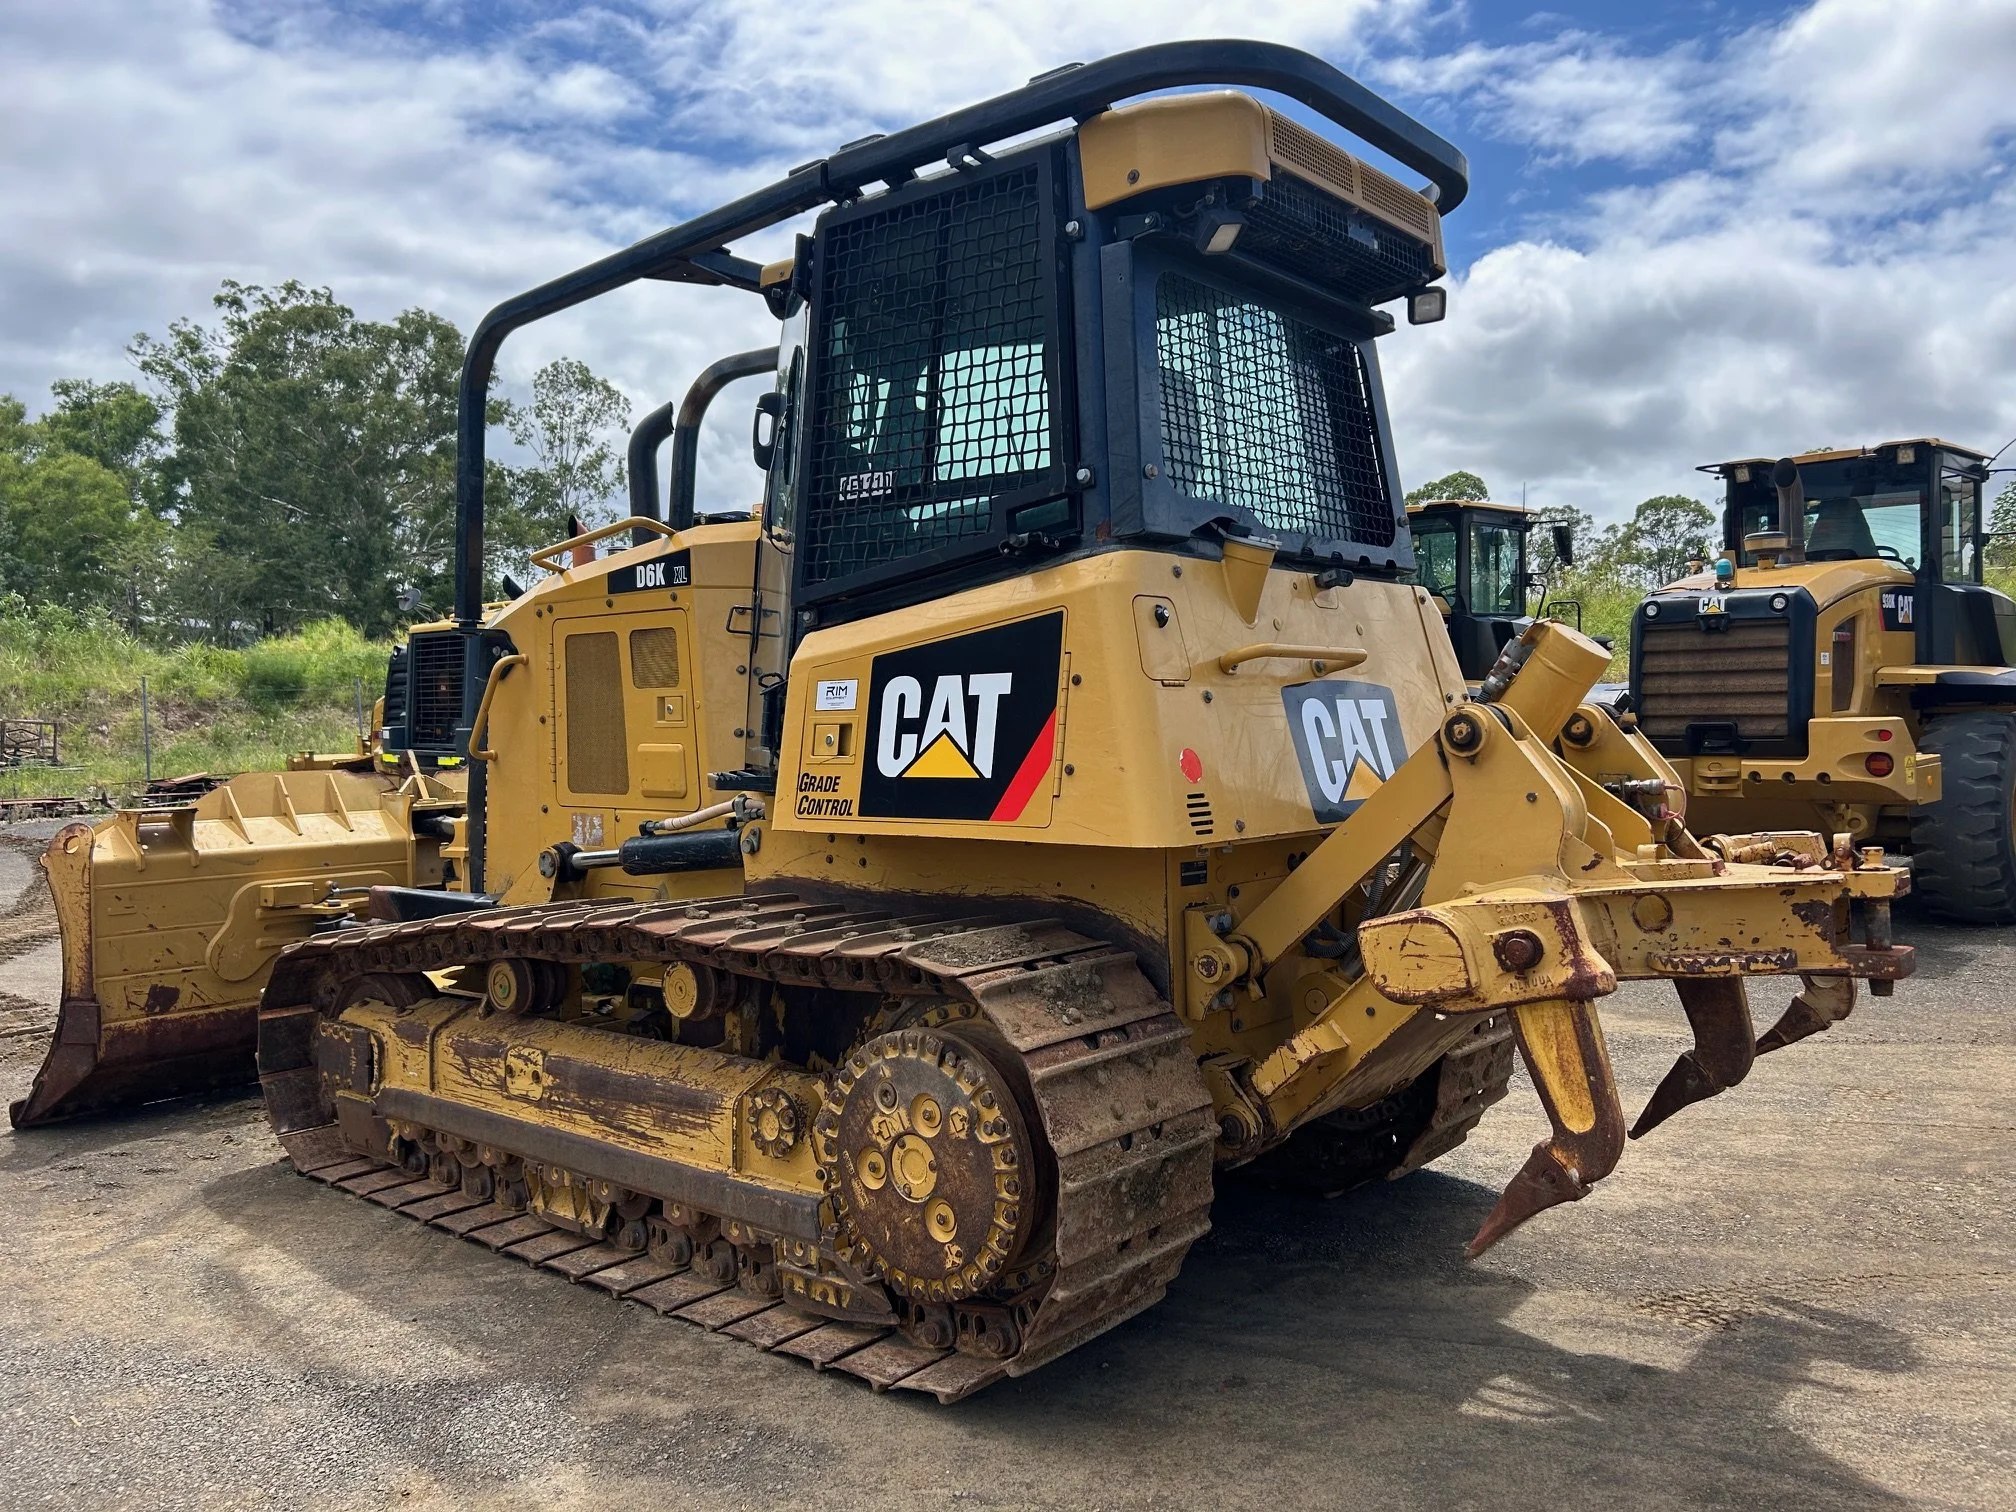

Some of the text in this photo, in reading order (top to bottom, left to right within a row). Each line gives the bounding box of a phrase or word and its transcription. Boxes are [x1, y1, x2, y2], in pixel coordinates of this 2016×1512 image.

[636, 562, 688, 588] D6K XL
[1698, 596, 1728, 614] CAT
[1897, 594, 1914, 624] CAT
[826, 685, 848, 697] RIM
[877, 672, 1013, 779] CAT
[1301, 697, 1396, 804] CAT
[799, 772, 841, 793] GRADE
[797, 794, 854, 817] CONTROL
